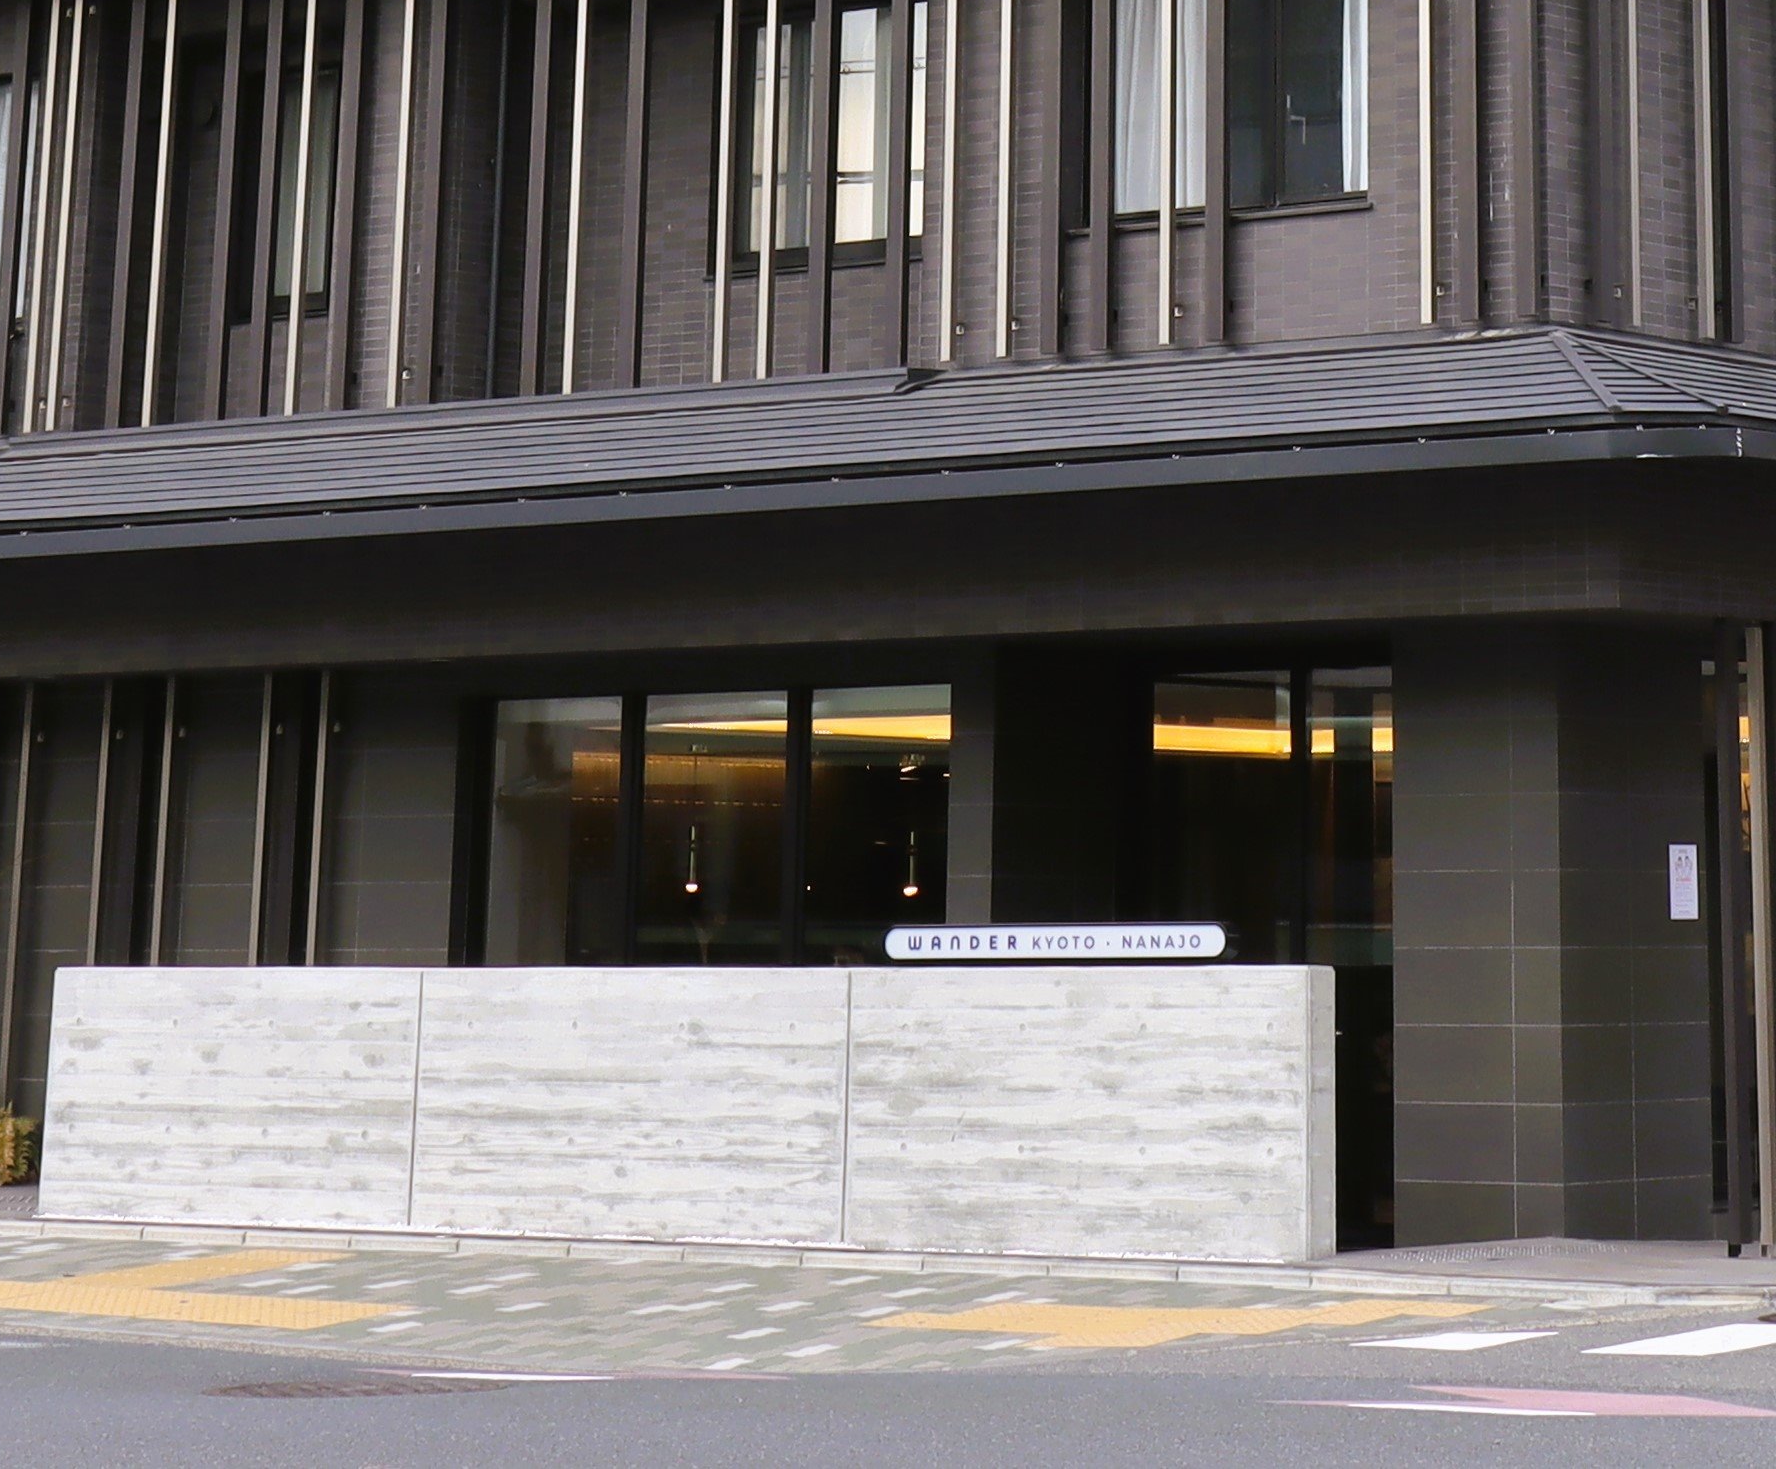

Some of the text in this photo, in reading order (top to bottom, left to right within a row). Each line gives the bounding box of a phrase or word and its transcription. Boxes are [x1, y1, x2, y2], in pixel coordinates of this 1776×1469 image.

[907, 934, 1202, 951] WANDER KYOTO NANAJO
